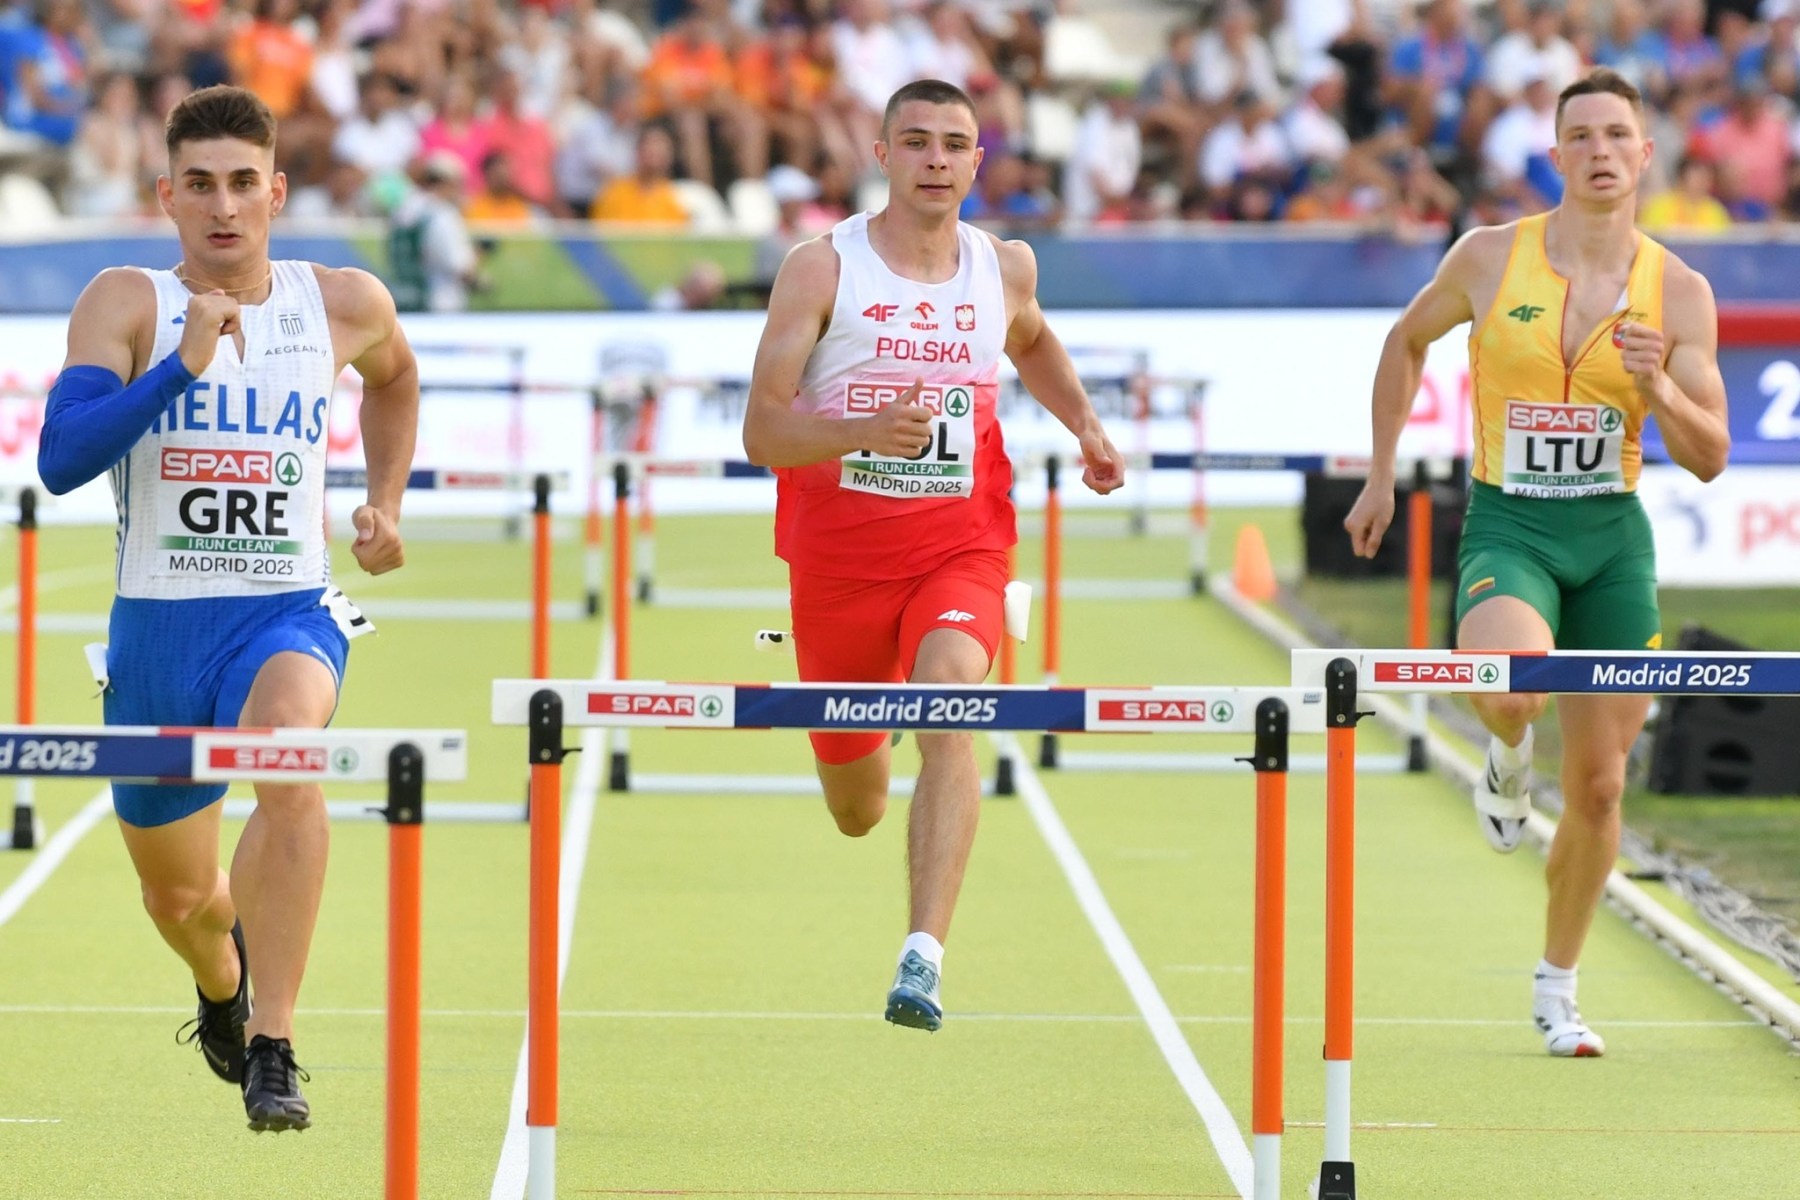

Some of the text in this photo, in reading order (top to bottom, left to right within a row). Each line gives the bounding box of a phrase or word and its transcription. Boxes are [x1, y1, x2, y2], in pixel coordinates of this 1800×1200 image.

[861, 303, 899, 322] 4F
[1508, 304, 1546, 322] 4F
[910, 321, 939, 331] ORLEN
[264, 345, 318, 356] AEGEAN
[876, 337, 971, 363] POLSKA
[1510, 406, 1596, 430] SPAR
[1526, 435, 1606, 473] LTU
[164, 452, 270, 479] SPAR
[869, 462, 874, 471] I
[876, 462, 903, 473] RUN
[853, 472, 963, 494] MADRID 2025
[1535, 475, 1559, 485] RUN
[179, 487, 289, 537] GRE
[188, 537, 193, 549] I
[195, 538, 226, 551] RUN
[169, 554, 294, 576] MADRID 2025
[936, 608, 977, 623] 4F
[1397, 665, 1472, 680] SPAR
[1592, 662, 1752, 687] Madrid 2025
[611, 696, 694, 713] SPAR
[823, 696, 999, 722] Madrid 2025
[1122, 702, 1206, 719] SPAR
[18, 739, 99, 771] 2025
[234, 748, 328, 771] SPAR
